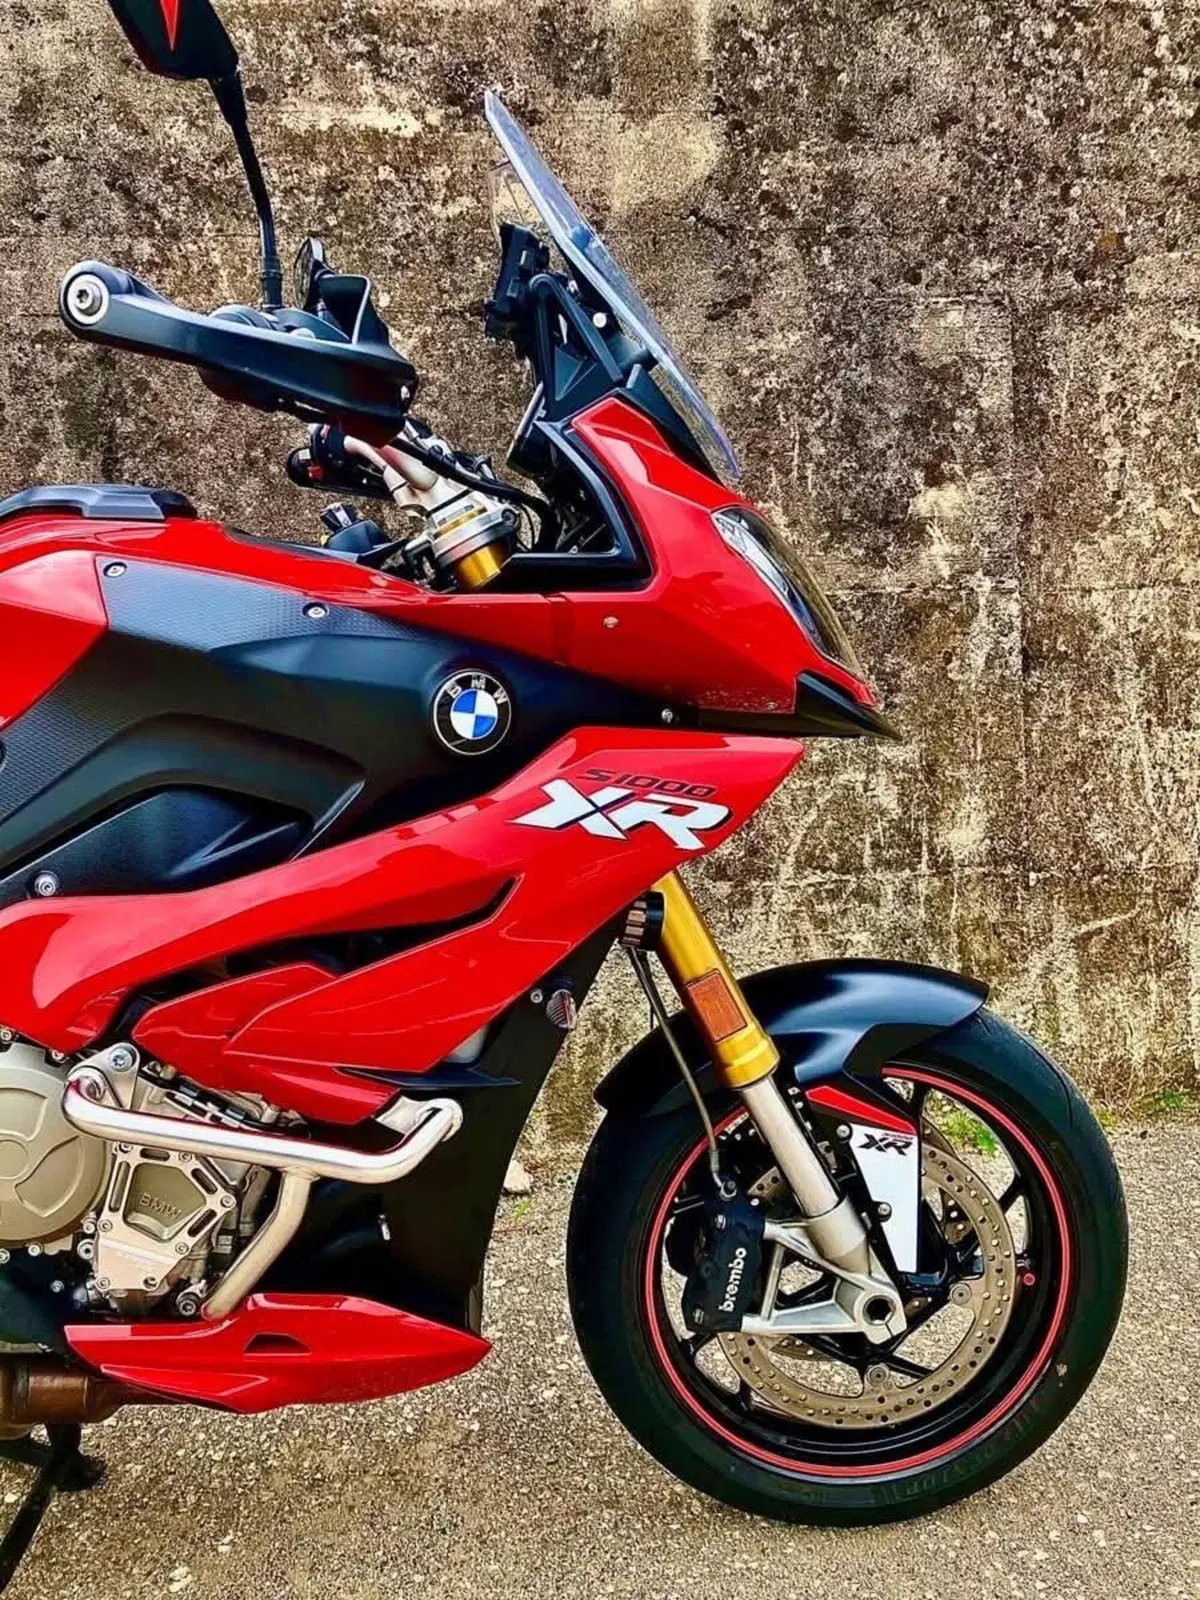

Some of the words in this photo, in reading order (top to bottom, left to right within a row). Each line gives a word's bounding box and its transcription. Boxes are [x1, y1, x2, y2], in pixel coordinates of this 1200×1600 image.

[445, 672, 509, 704] BMW
[505, 777, 733, 850] XR
[858, 1133, 913, 1156] XR
[140, 1193, 182, 1219] BMW
[718, 1247, 747, 1312] brembo
